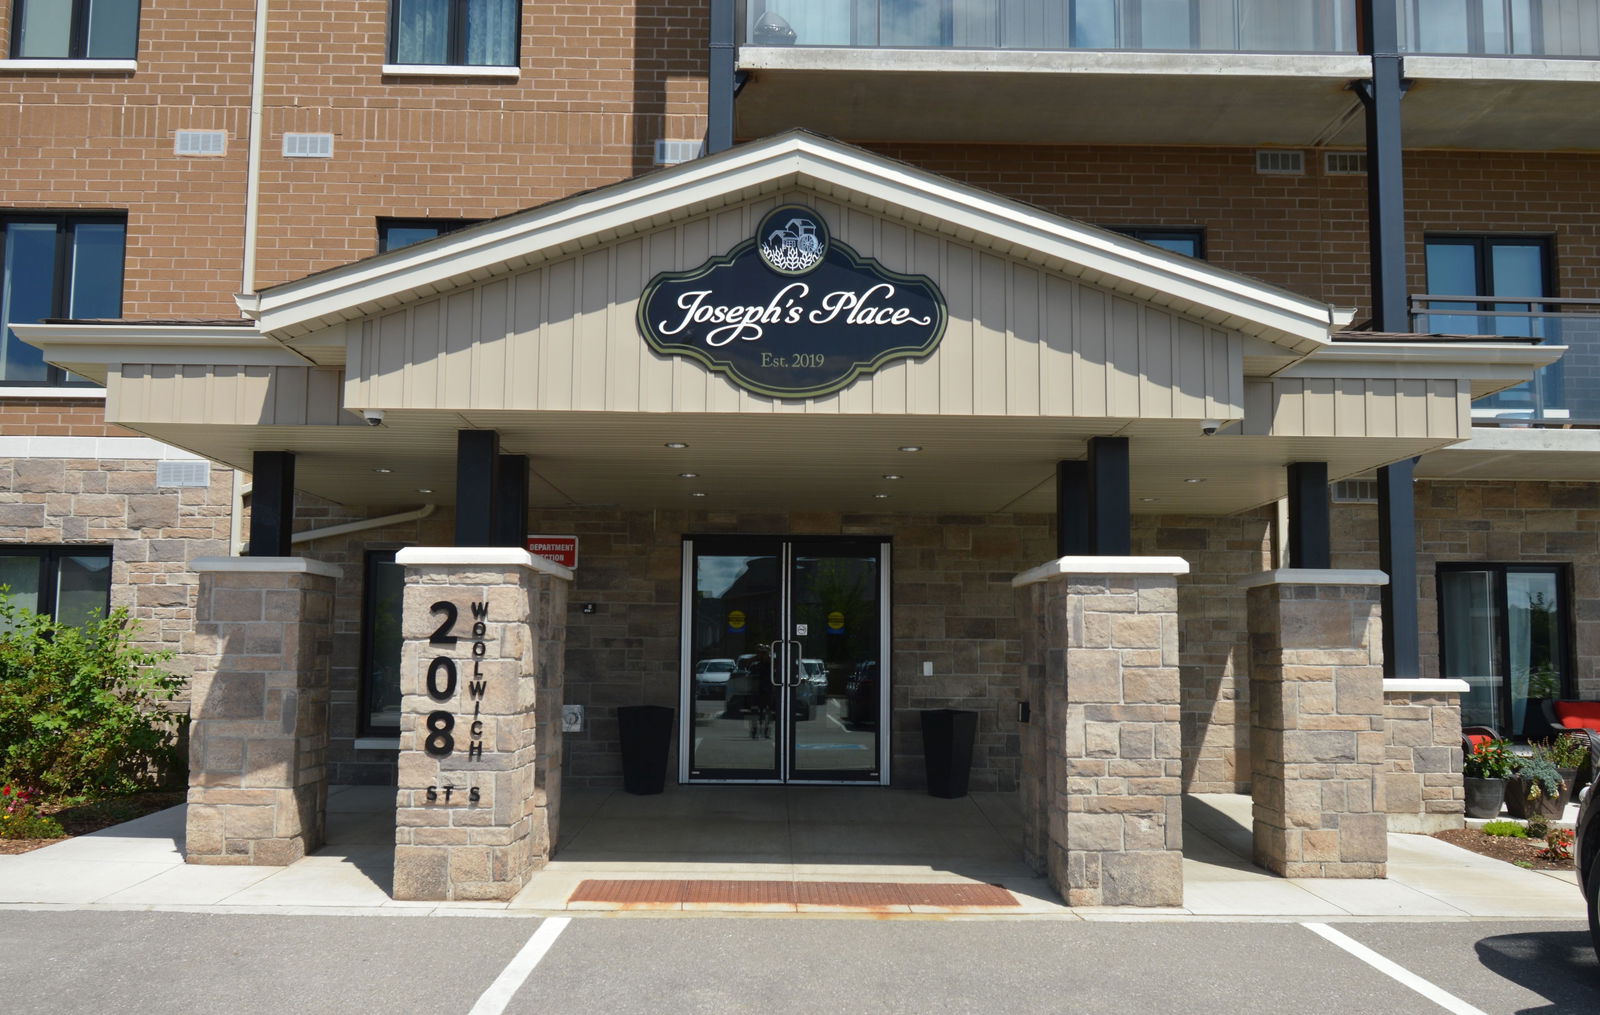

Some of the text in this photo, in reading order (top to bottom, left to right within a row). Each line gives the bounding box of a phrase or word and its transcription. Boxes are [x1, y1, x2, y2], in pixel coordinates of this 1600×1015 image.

[658, 282, 931, 346] Joseph's Place
[761, 352, 825, 368] Est. 2019
[425, 600, 458, 756] 208
[469, 601, 489, 760] WOOLWICH
[426, 785, 481, 802] ST S
